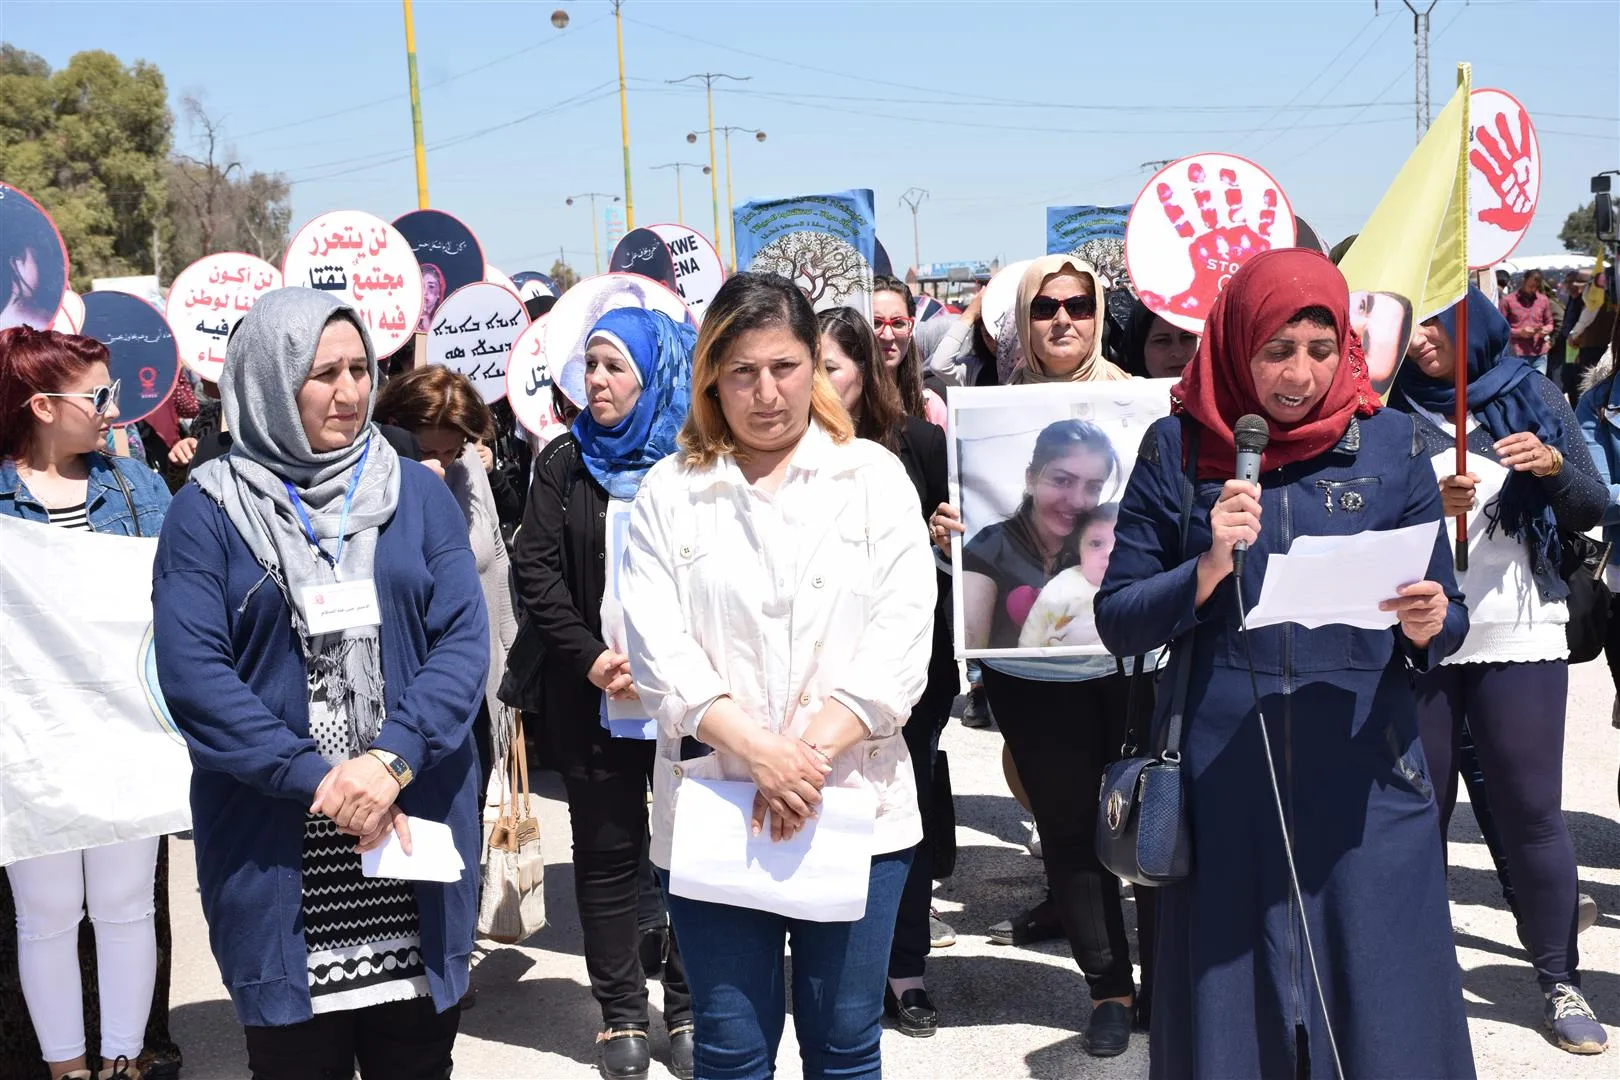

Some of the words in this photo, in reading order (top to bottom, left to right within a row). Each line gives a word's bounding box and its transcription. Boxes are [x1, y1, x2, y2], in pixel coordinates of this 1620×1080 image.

[369, 226, 387, 256] لن
[1206, 258, 1240, 275] STO
[254, 271, 274, 291] لن
[196, 319, 229, 340] فيه
[379, 305, 407, 338] فيه
